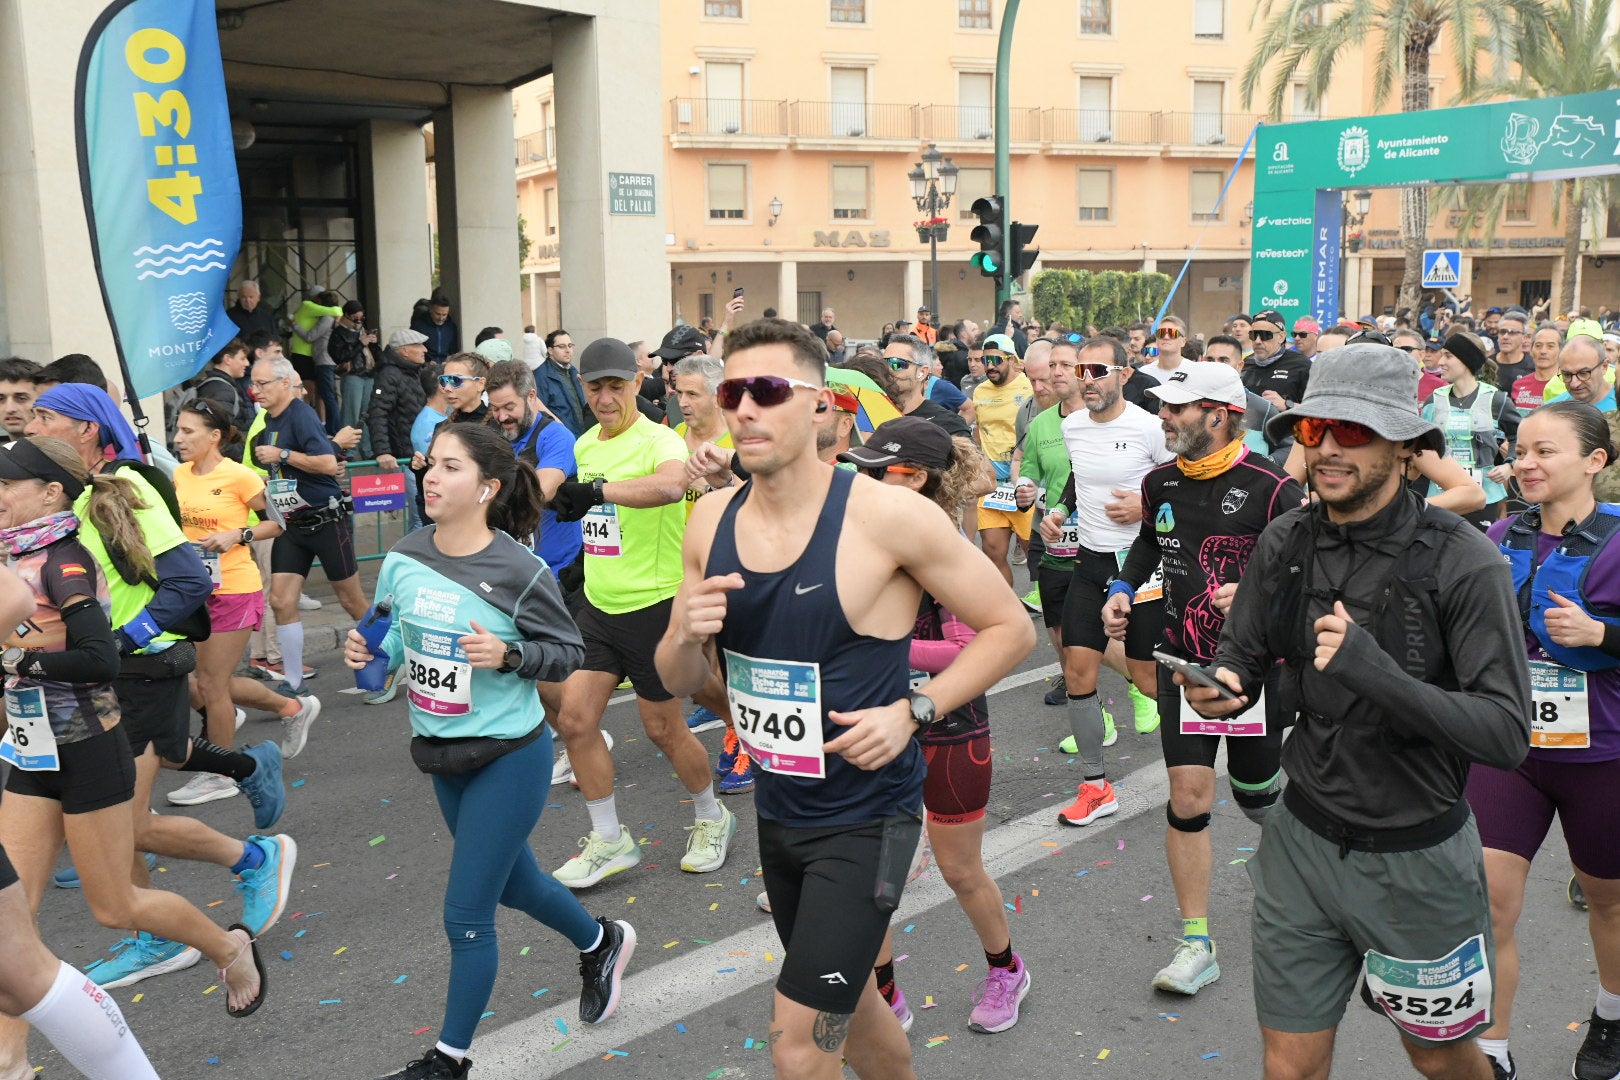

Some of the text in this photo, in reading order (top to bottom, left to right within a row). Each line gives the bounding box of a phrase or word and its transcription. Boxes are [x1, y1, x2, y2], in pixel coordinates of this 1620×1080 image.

[125, 28, 203, 225] 4:30
[1377, 135, 1449, 150] Ayuntamiento
[1384, 147, 1440, 159] de Alicante
[619, 175, 652, 186] CARRER
[626, 189, 633, 197] LA
[615, 199, 652, 212] DEL PALAU
[1268, 217, 1312, 225] vectalia
[813, 230, 891, 248] MAZ
[1261, 296, 1299, 308] Coplaca
[990, 490, 1014, 502] 2915
[409, 658, 458, 693] 3884
[737, 703, 806, 742] 3740
[1417, 971, 1448, 982] Elche
[1417, 972, 1462, 986] Alicante
[1382, 987, 1475, 1018] 3524
